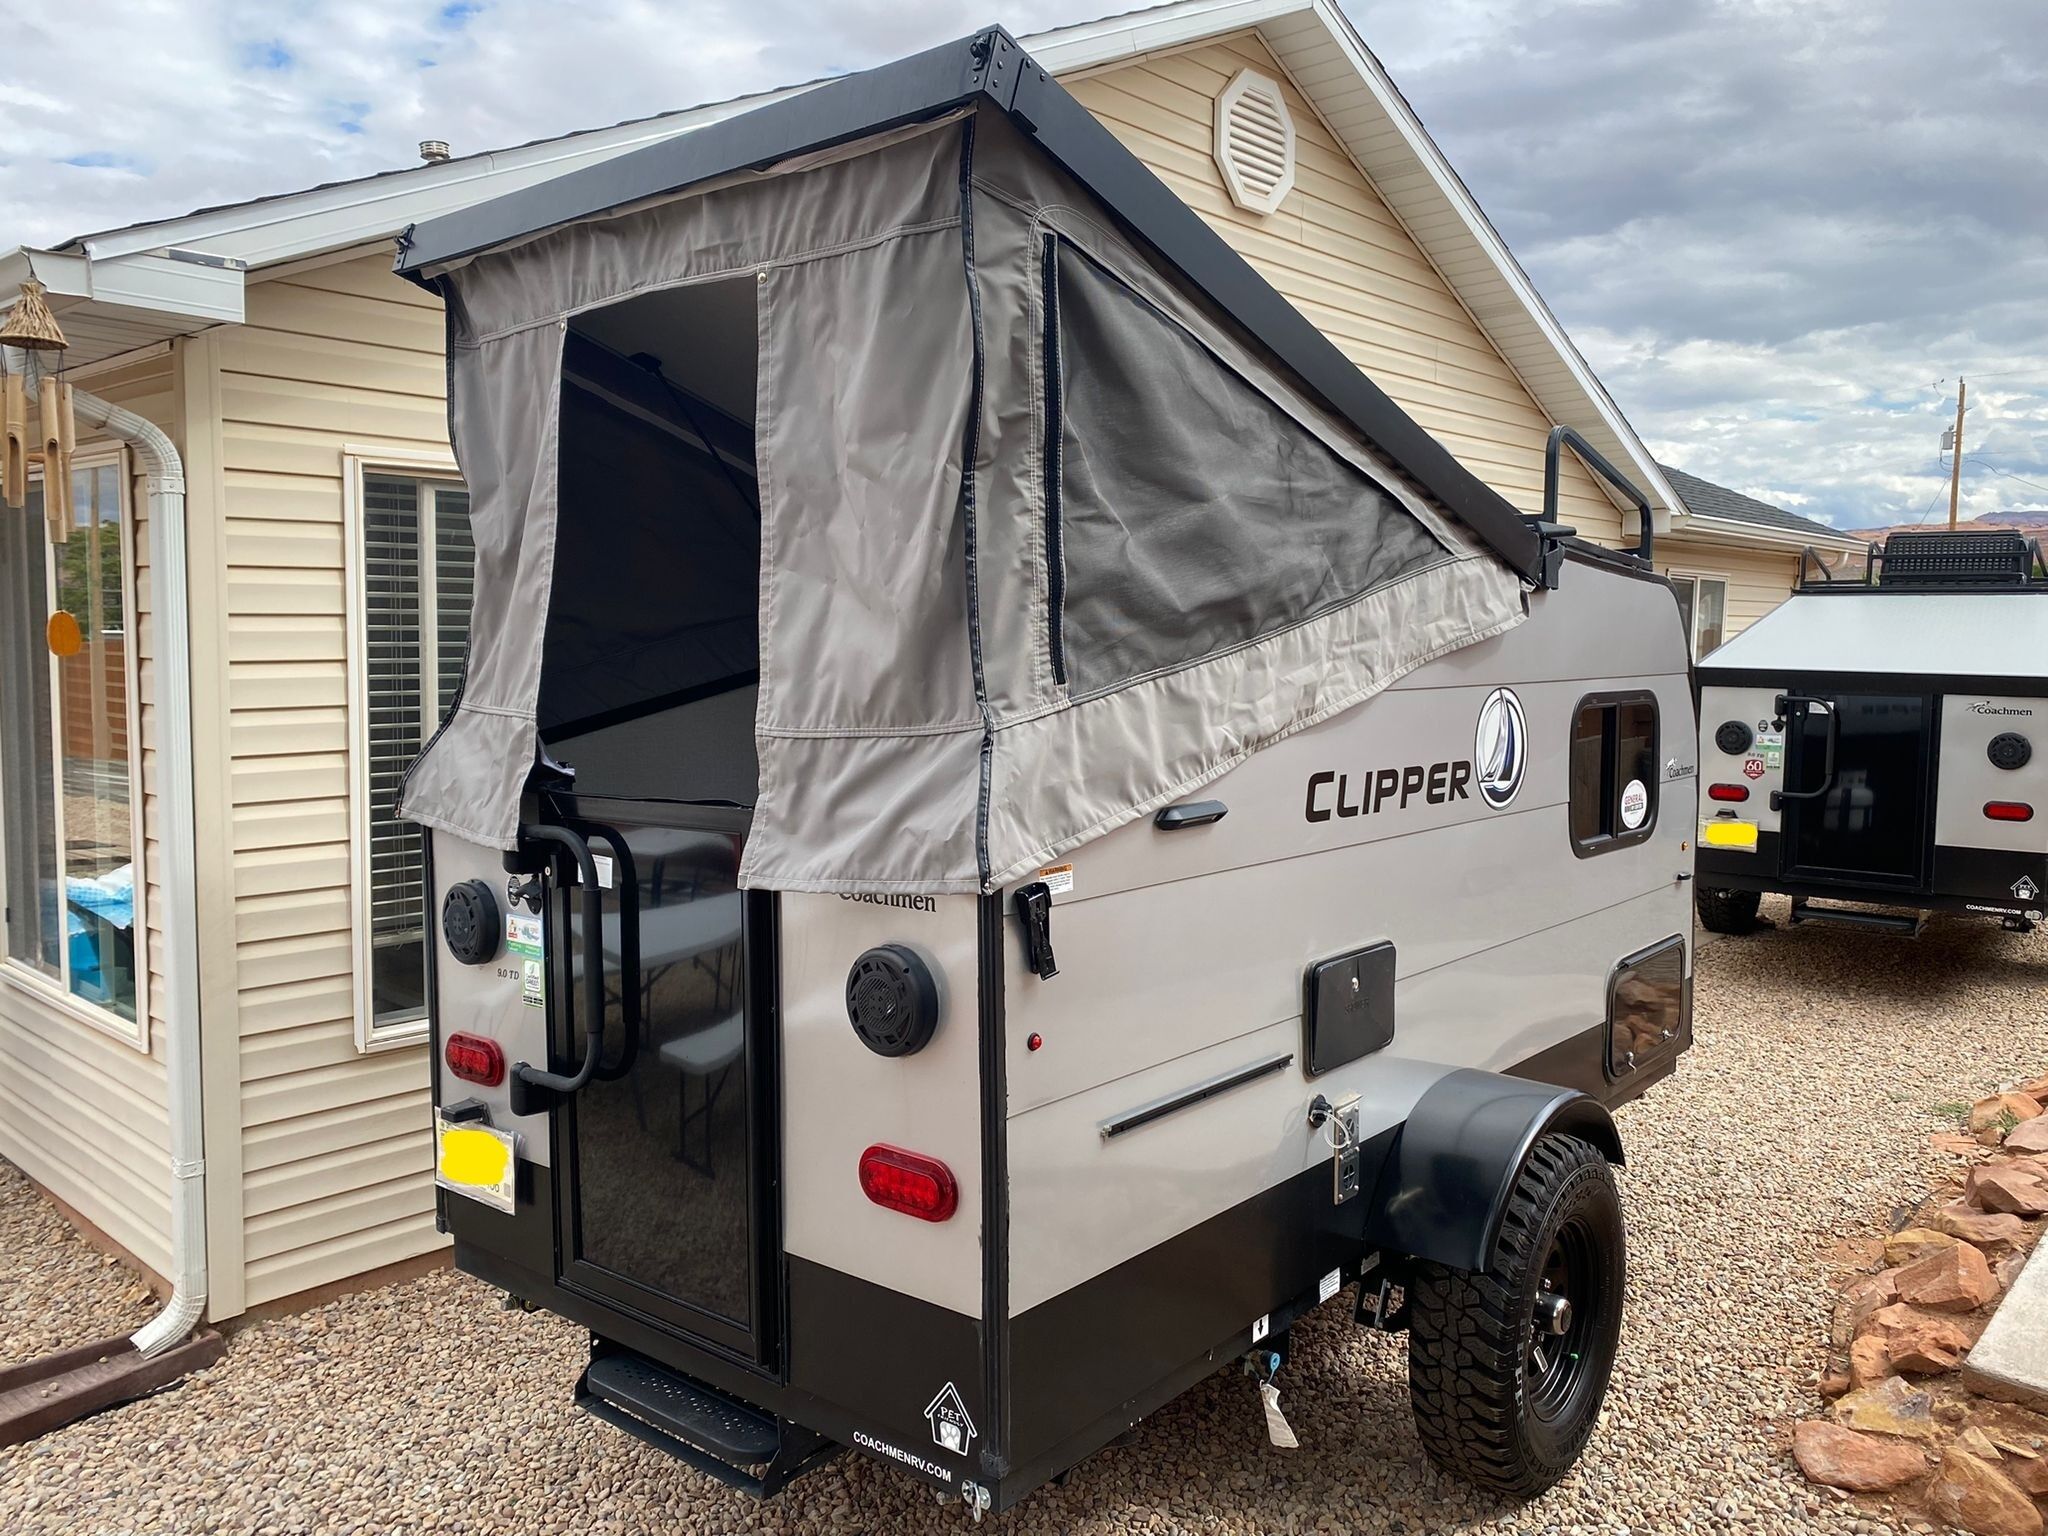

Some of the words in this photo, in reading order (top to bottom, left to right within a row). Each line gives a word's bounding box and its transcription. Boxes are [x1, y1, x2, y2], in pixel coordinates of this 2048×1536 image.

[1977, 707, 2032, 716] Coachmen
[1747, 761, 1761, 770] 60
[1305, 760, 1471, 823] CLIPPER
[1965, 904, 2022, 915] COACHMENRV.COM
[497, 968, 508, 978] 9.0
[509, 970, 520, 980] TD
[940, 1406, 961, 1421] PET
[853, 1431, 952, 1482] COACHMENRV.COM
